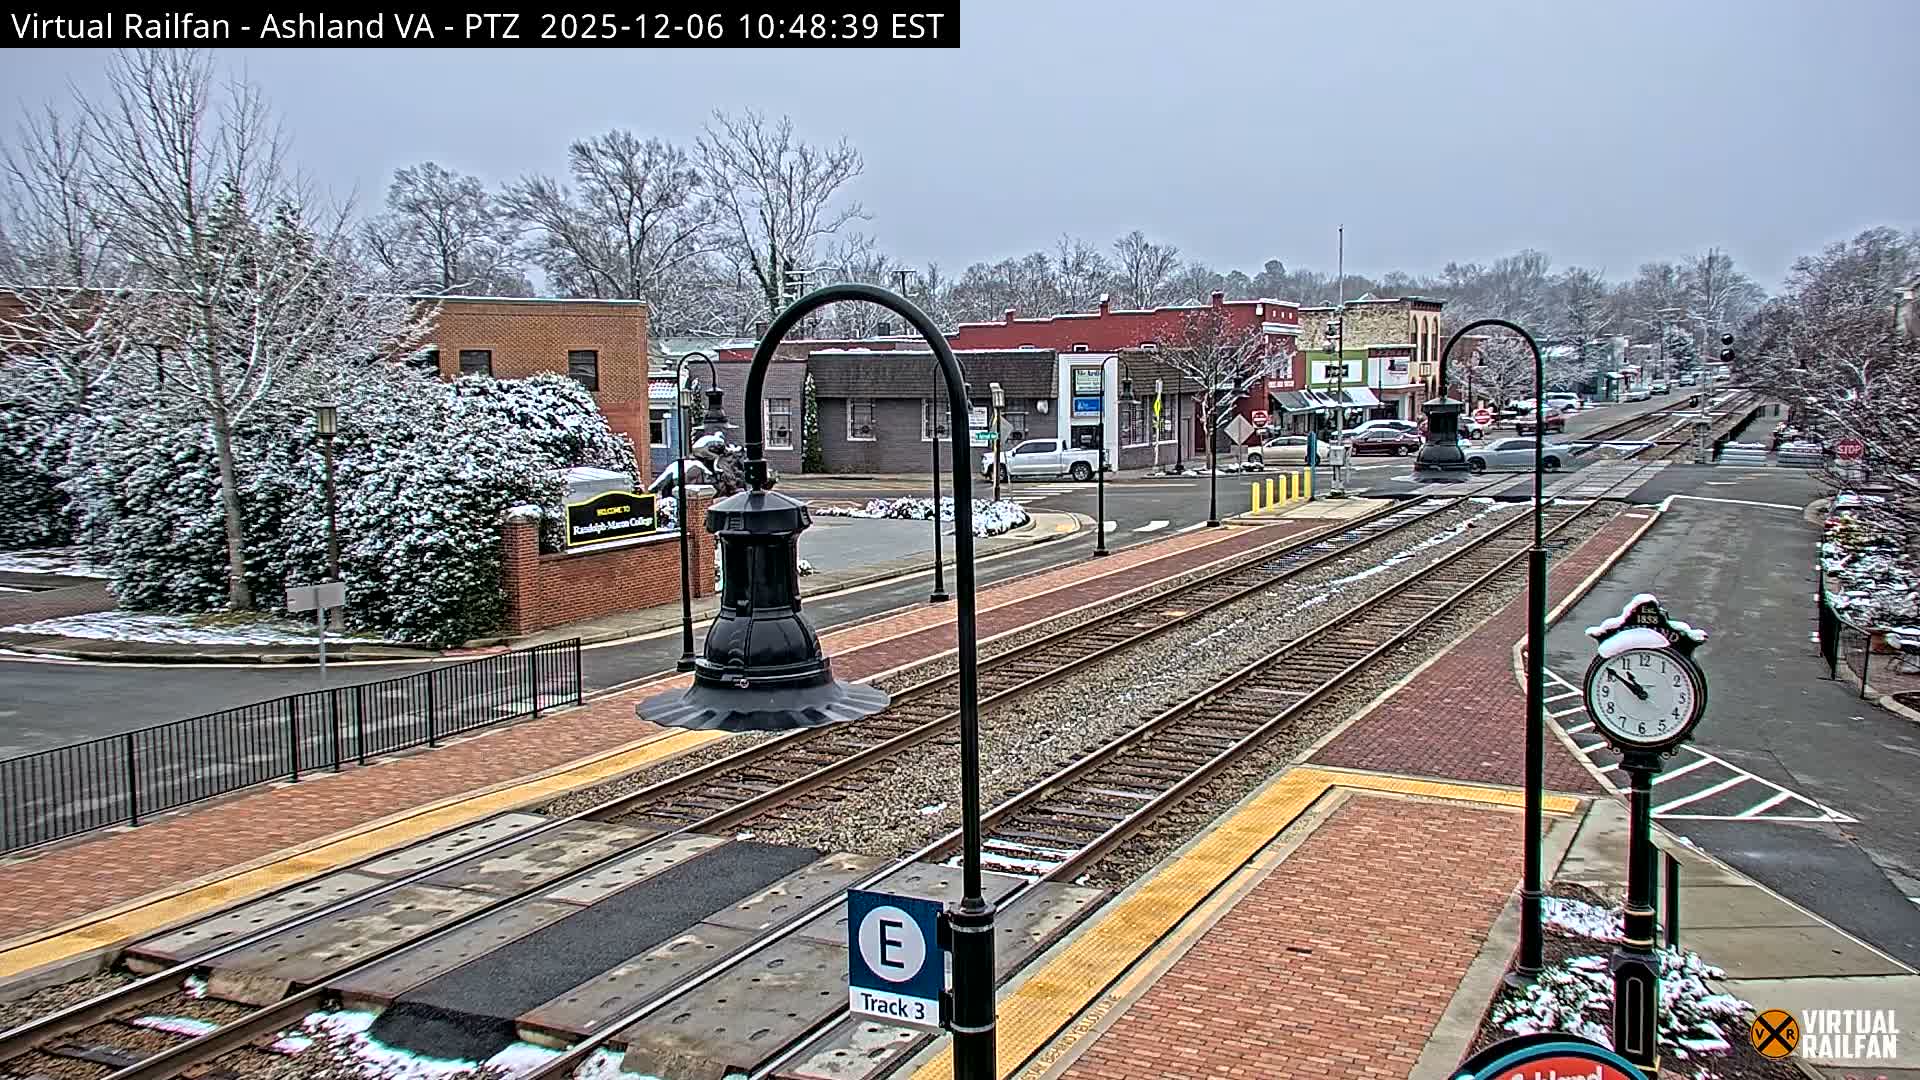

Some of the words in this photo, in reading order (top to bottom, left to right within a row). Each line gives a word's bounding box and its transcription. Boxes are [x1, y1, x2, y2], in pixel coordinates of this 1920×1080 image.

[1839, 445, 1861, 454] STOP
[1637, 615, 1658, 624] 1858
[1622, 658, 1631, 670] 11
[1640, 655, 1650, 667] 12
[1661, 661, 1666, 674] 1
[1673, 676, 1680, 687] 2
[1602, 686, 1609, 697] 9
[1680, 693, 1686, 704] 3
[1606, 703, 1614, 714] 8
[1672, 707, 1680, 719] 4
[1618, 717, 1627, 728] 7
[1638, 722, 1646, 734] 6
[1658, 720, 1666, 731] 5
[880, 919, 904, 968] E
[861, 993, 908, 1017] Track
[914, 1002, 925, 1020] 3
